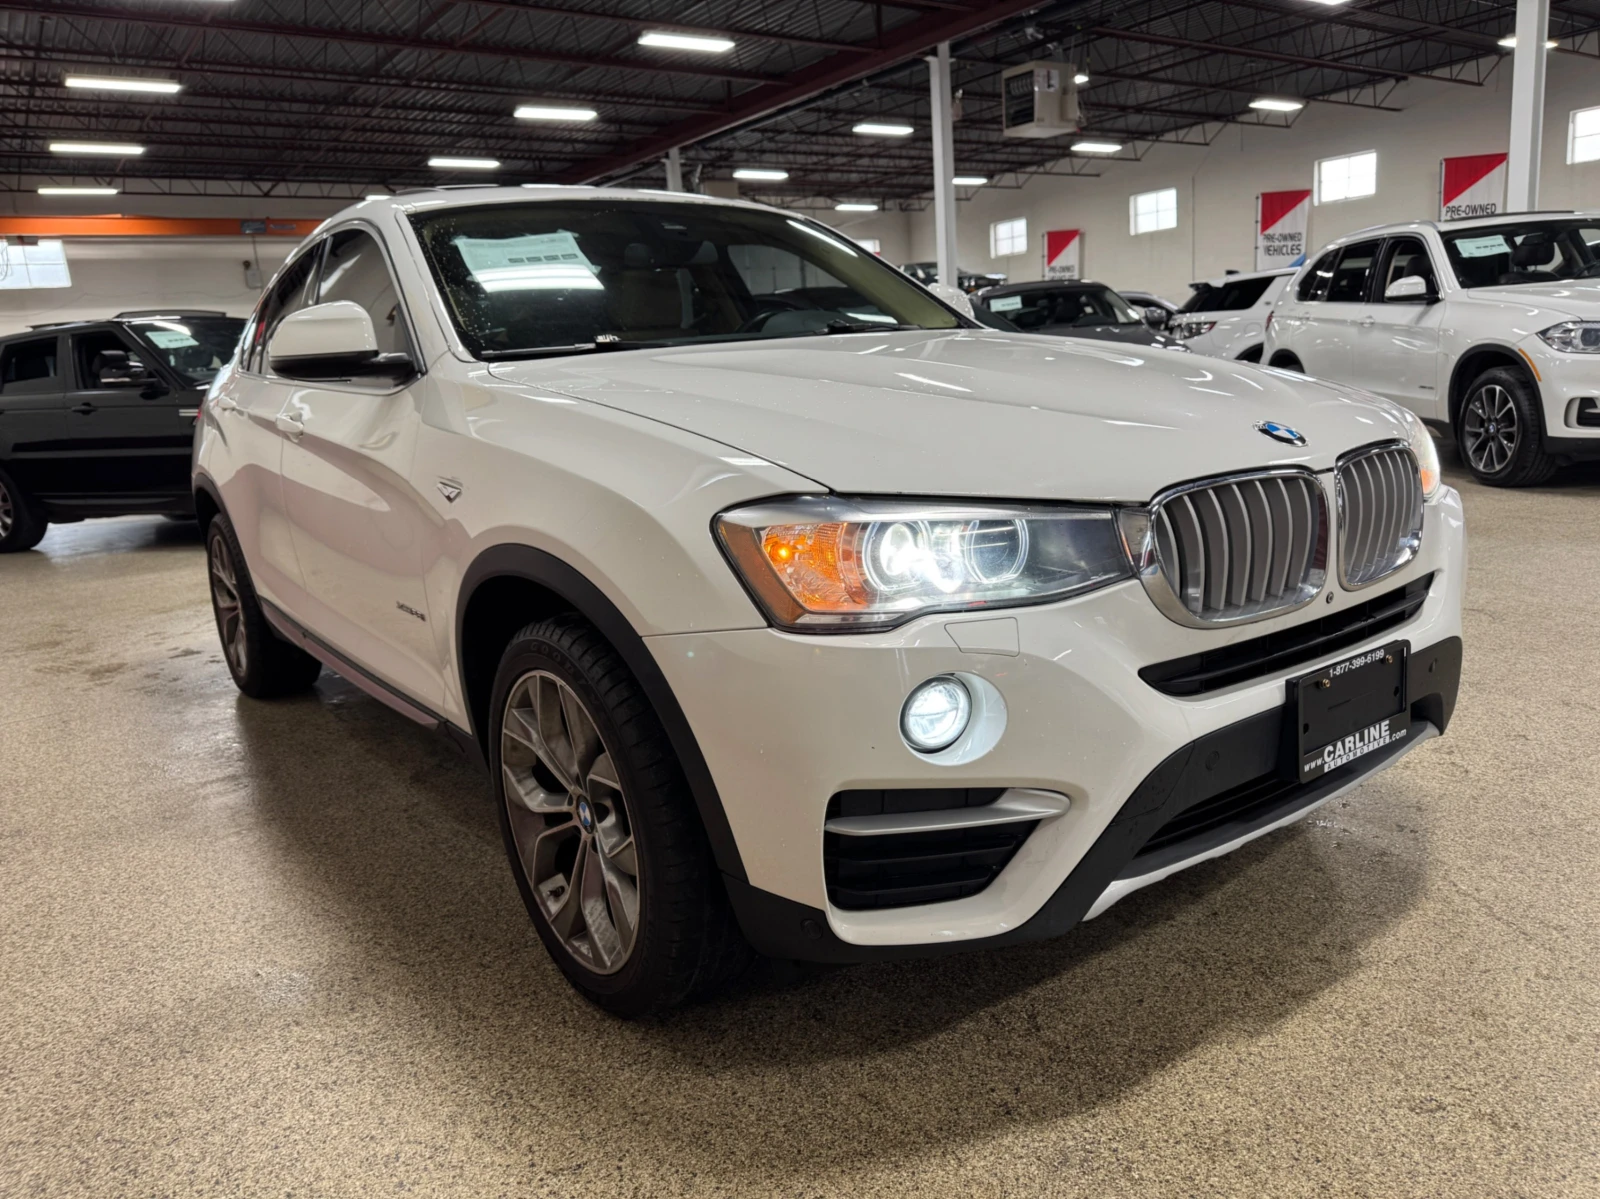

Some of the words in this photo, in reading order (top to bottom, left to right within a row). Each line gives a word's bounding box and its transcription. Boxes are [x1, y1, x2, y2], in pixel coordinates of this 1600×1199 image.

[1445, 203, 1497, 217] PRE-OWNED
[1263, 232, 1302, 243] PRE-OWNED
[1263, 244, 1302, 256] VEHICLES
[1329, 649, 1385, 678] 1-877-399-6199
[1326, 736, 1388, 771] AUTOMOTIVE
